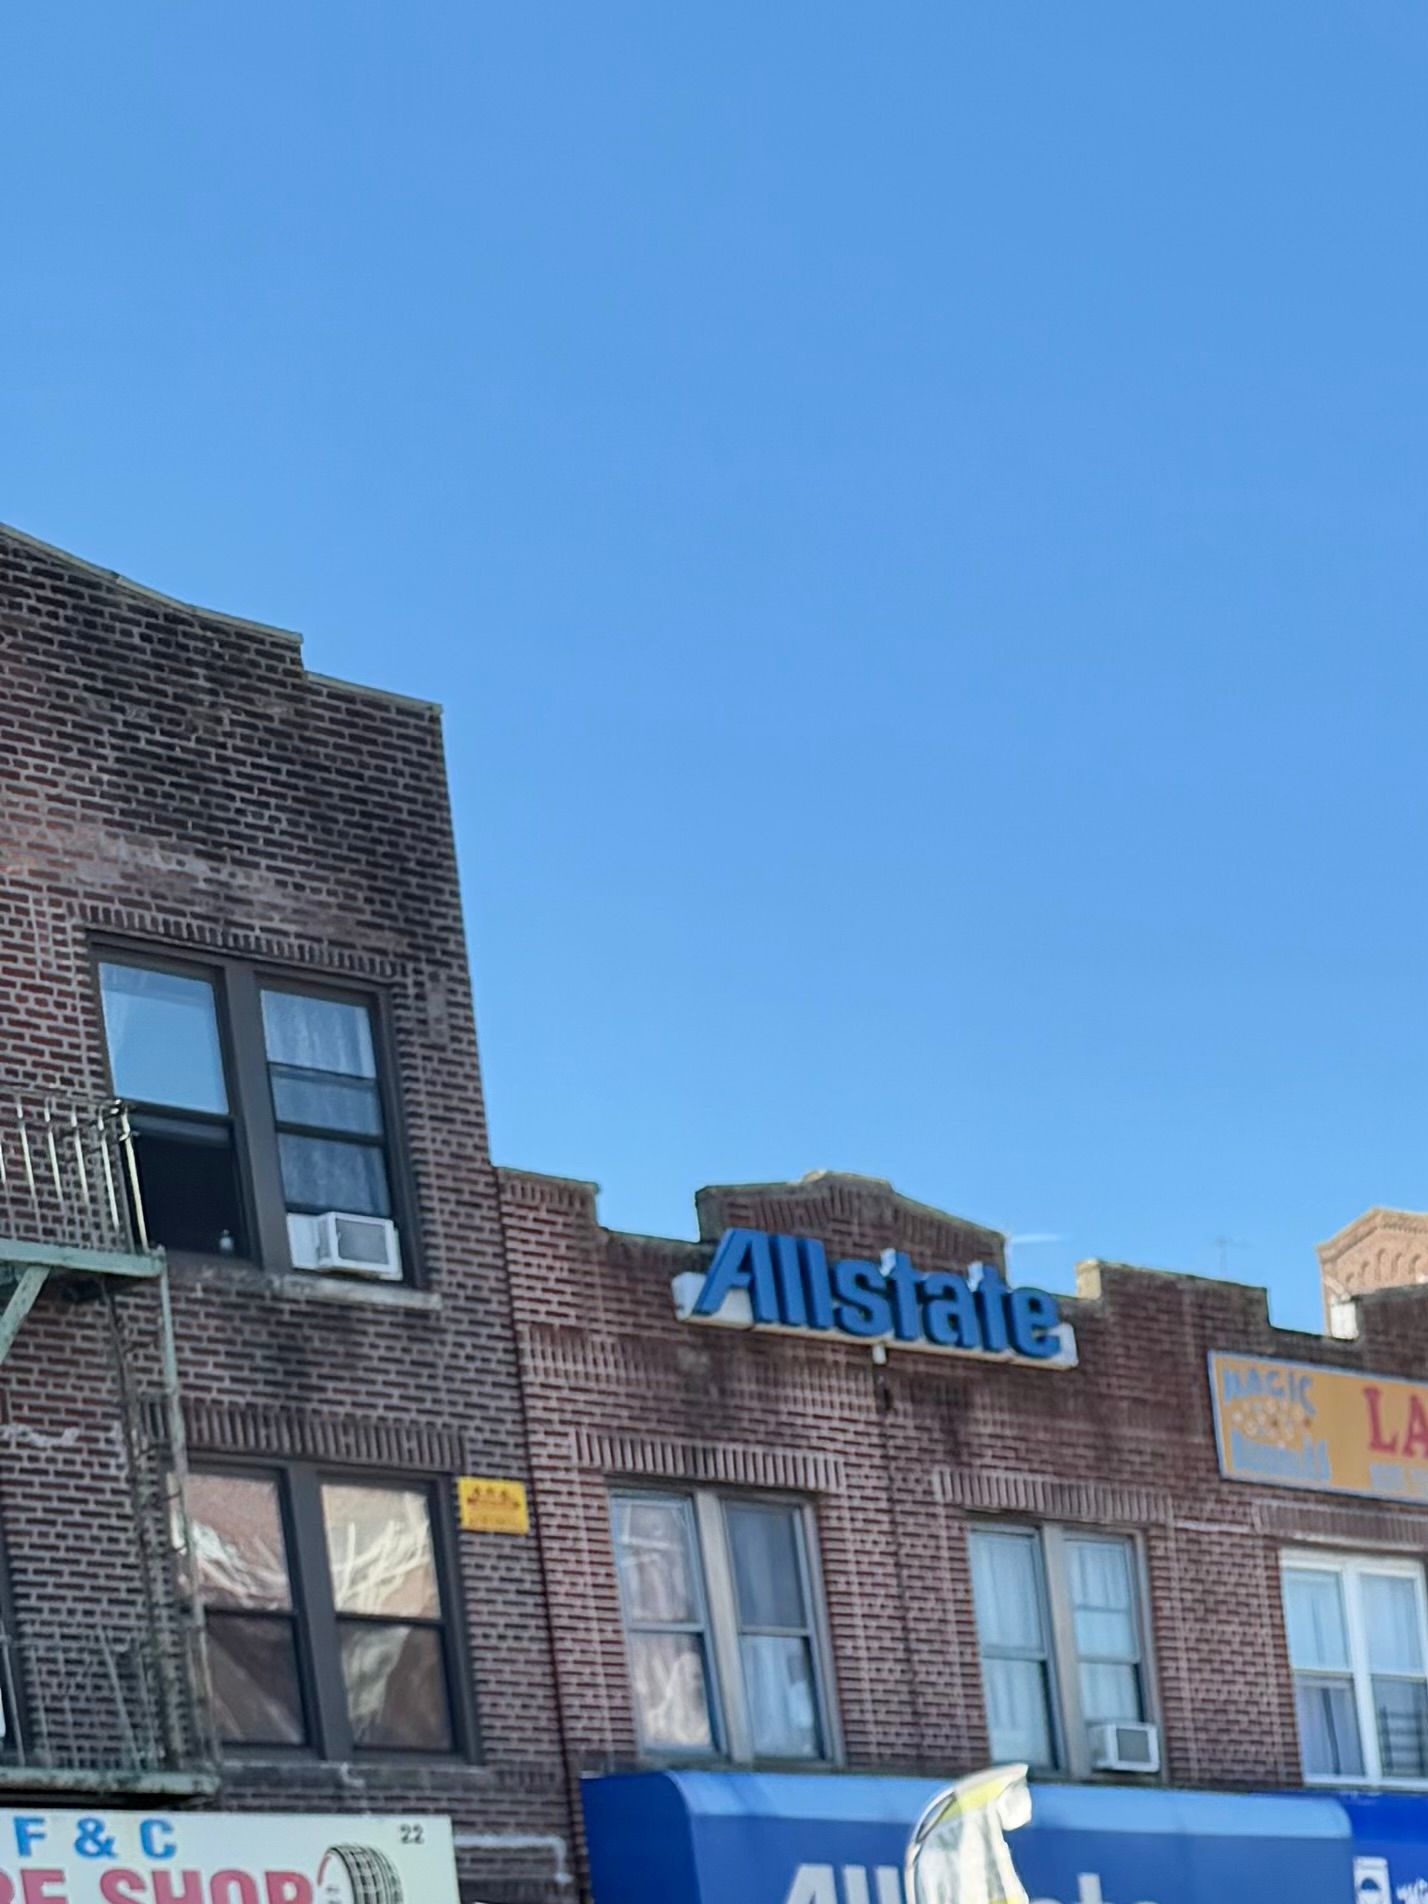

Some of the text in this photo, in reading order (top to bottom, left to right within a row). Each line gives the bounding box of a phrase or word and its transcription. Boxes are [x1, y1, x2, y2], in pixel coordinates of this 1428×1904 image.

[689, 1228, 1061, 1360] Allstate
[14, 1816, 177, 1860] F & C
